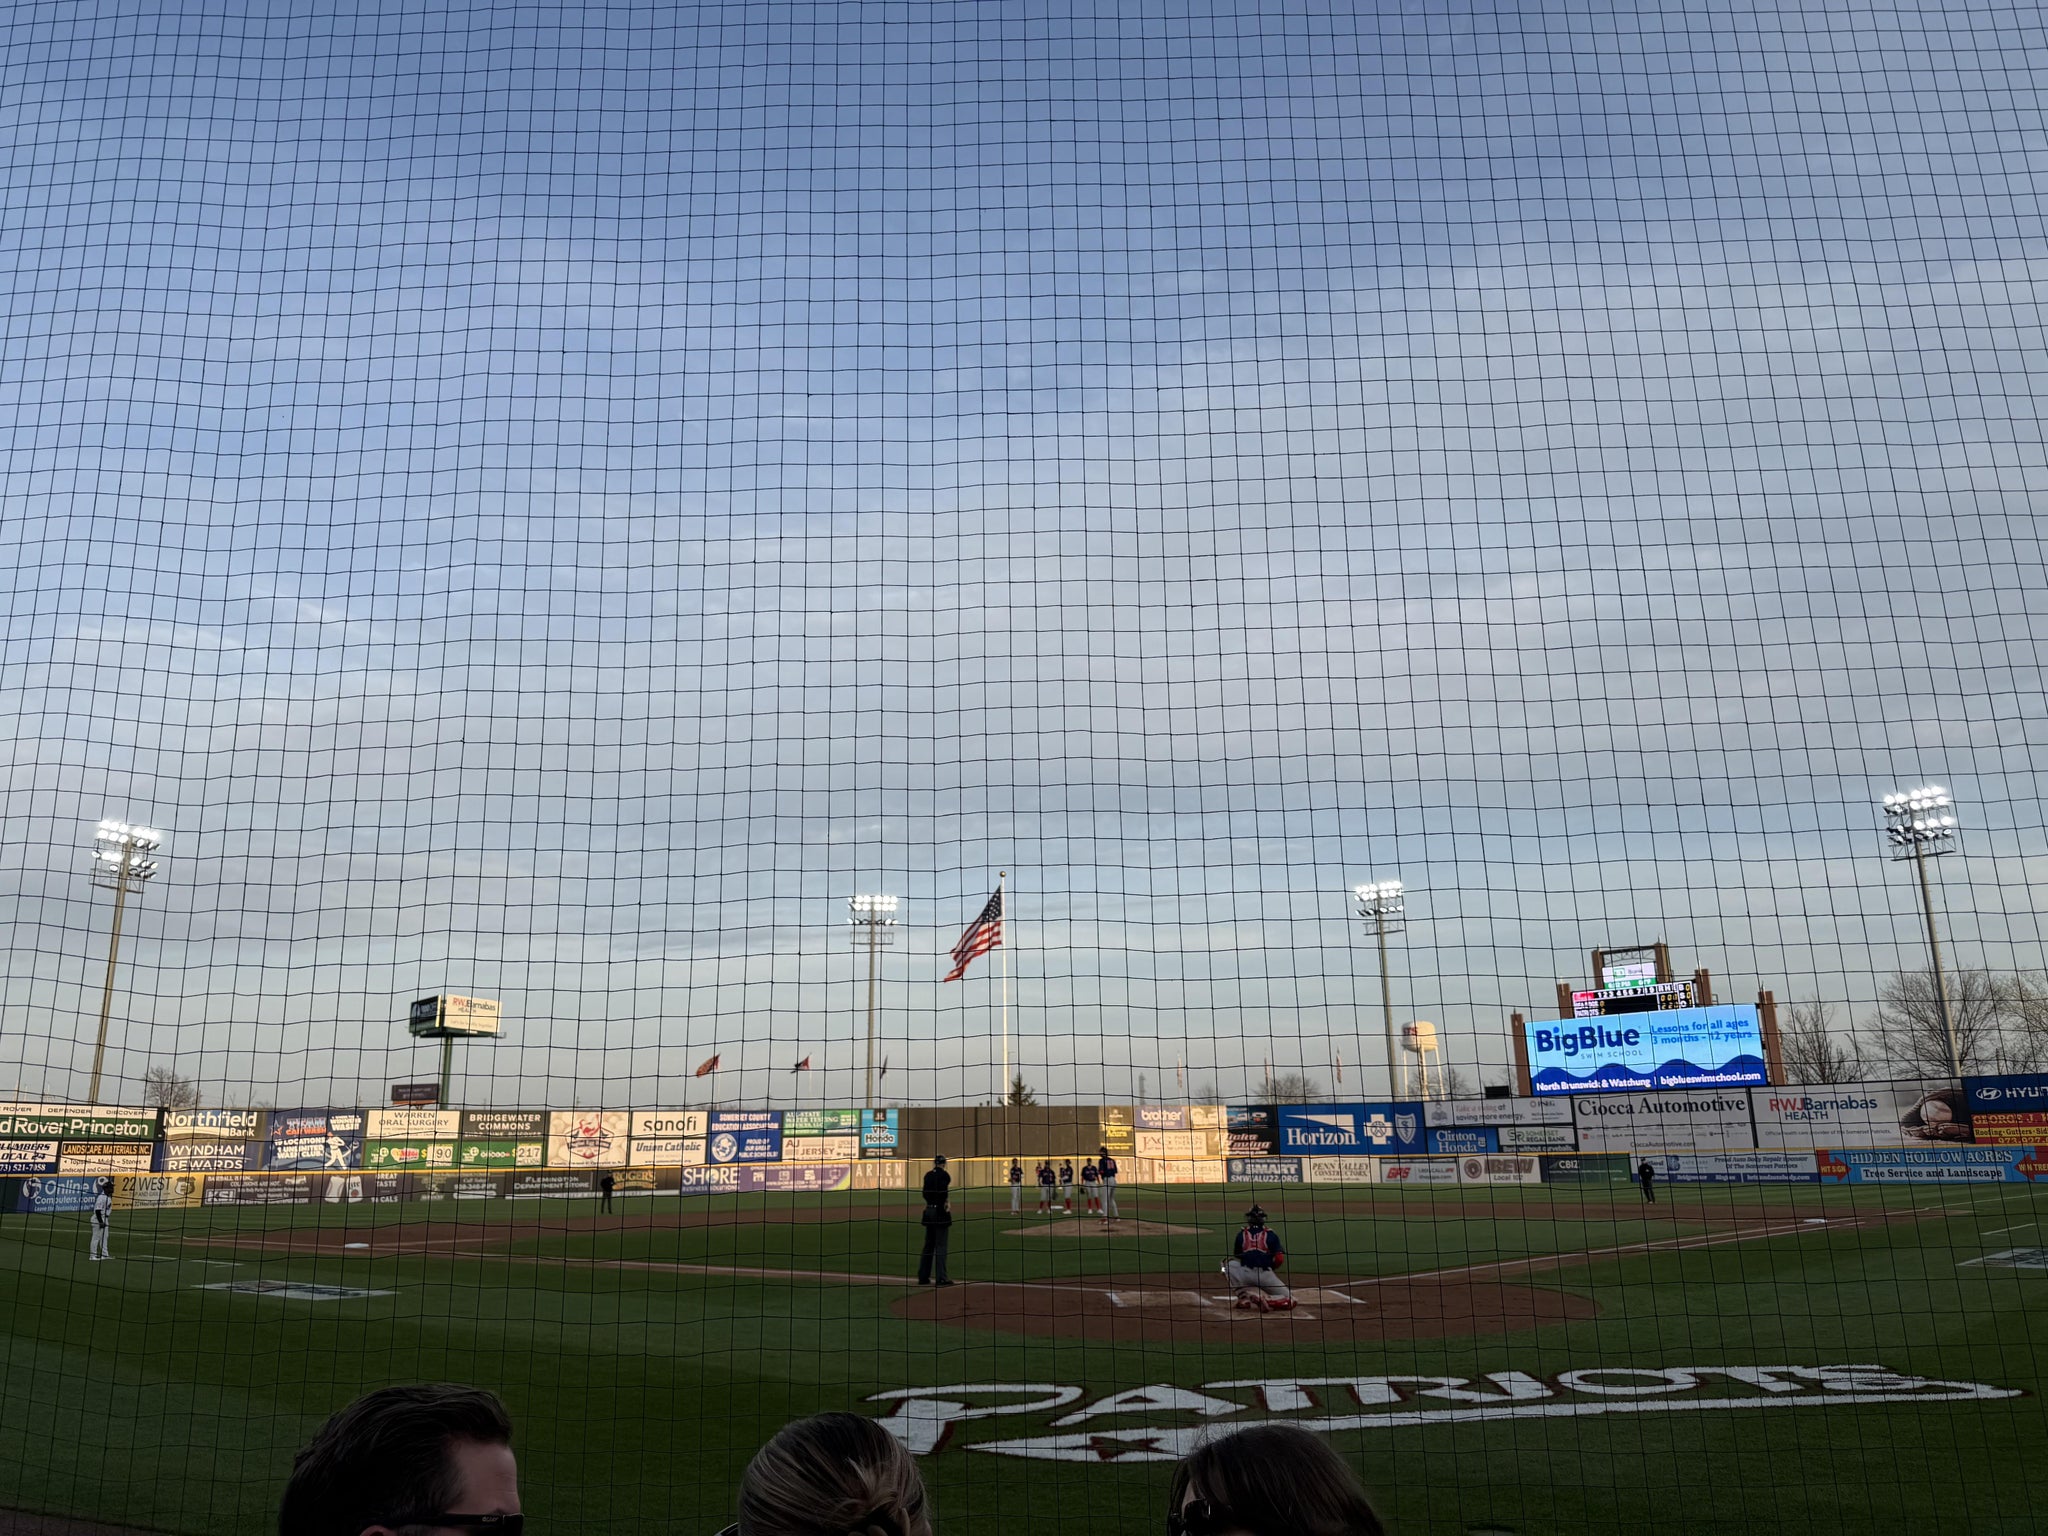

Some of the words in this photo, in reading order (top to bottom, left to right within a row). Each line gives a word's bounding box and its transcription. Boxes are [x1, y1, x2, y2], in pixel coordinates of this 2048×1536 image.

[1652, 1024, 1690, 1033] Lessons
[1693, 1022, 1707, 1031] for
[1710, 1020, 1723, 1030] all
[1726, 1020, 1749, 1030] ages
[1536, 1026, 1640, 1057] BigBlue
[1661, 1033, 1699, 1044] months
[1724, 1031, 1752, 1043] years
[1537, 1082, 1560, 1091] North
[1561, 1079, 1601, 1090] Brunswick
[1602, 1079, 1608, 1088] &
[1609, 1077, 1651, 1088] Watchung
[1578, 1100, 1635, 1116] Ciocca
[1638, 1096, 1746, 1114] Automotive
[1769, 1095, 1878, 1112] RWJBarnabas
[163, 1111, 257, 1127] Northfield
[470, 1114, 541, 1122] BRIDGEWATER
[1141, 1110, 1181, 1121] brother
[1785, 1111, 1828, 1120] HEALTH
[1973, 1114, 2023, 1125] GEORGE
[15, 1117, 67, 1134] Rover
[70, 1119, 148, 1136] Princeton
[644, 1116, 697, 1132] sanofi
[230, 1128, 254, 1136] Bank
[1287, 1127, 1357, 1145] Horizon
[1436, 1130, 1476, 1142] Clinton
[865, 1134, 894, 1144] Honda
[103, 1145, 137, 1154] MATERIALS
[170, 1144, 245, 1156] WYNDHAM
[636, 1142, 662, 1152] Union
[664, 1142, 701, 1151] Catholic
[1438, 1141, 1478, 1152] Honda
[436, 1148, 452, 1158] 90
[518, 1148, 540, 1158] 217
[1850, 1153, 1901, 1165] HIDDEN
[1905, 1151, 1962, 1164] HOLLOW
[1966, 1151, 2012, 1164] ACRES
[168, 1159, 243, 1170] REWARDS
[1245, 1164, 1298, 1174] SMART
[1484, 1159, 1534, 1174] IBEW
[1559, 1160, 1579, 1169] CBIZ
[683, 1167, 740, 1185] SHORE
[1863, 1169, 1885, 1178] Tree
[1888, 1168, 1920, 1178] Service
[1925, 1168, 1943, 1177] and
[1948, 1167, 2002, 1180] Landscape
[45, 1180, 89, 1194] Online
[122, 1177, 136, 1191] 22
[139, 1177, 172, 1190] WEST
[35, 1196, 95, 1206] Computers.com
[208, 1191, 233, 1202] KSI
[862, 1363, 2024, 1455] PATRIOTS
